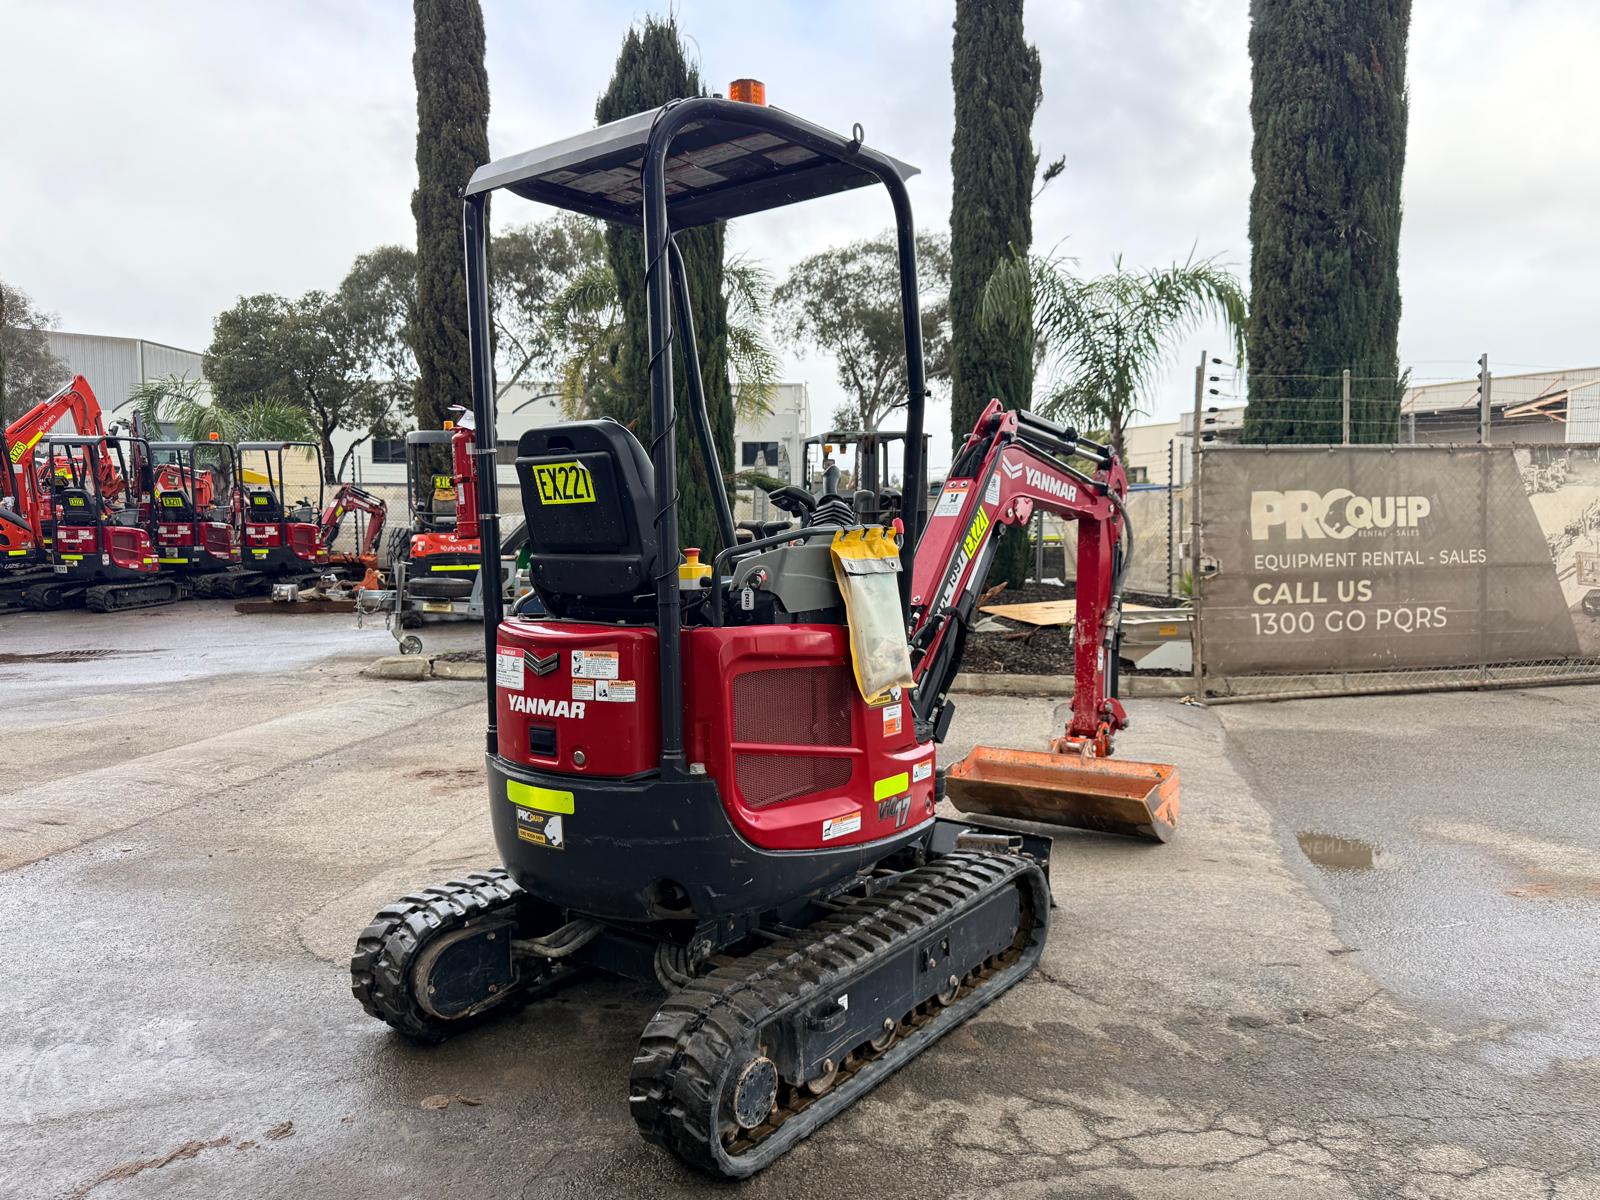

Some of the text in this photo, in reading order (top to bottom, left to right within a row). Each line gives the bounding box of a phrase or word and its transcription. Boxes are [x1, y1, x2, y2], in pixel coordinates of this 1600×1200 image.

[537, 466, 591, 500] EX221
[1025, 466, 1077, 503] YANMAR
[1358, 529, 1387, 537] RENTAL
[1396, 529, 1420, 537] SALES
[440, 544, 467, 552] Kubota
[1254, 552, 1357, 571] EQUIPMENT
[1362, 551, 1424, 566] RENTAL
[1439, 549, 1487, 565] SALES
[1253, 580, 1373, 605] CALL US
[1251, 607, 1448, 636] 1300 GO PQRS
[508, 694, 586, 719] YANMAR
